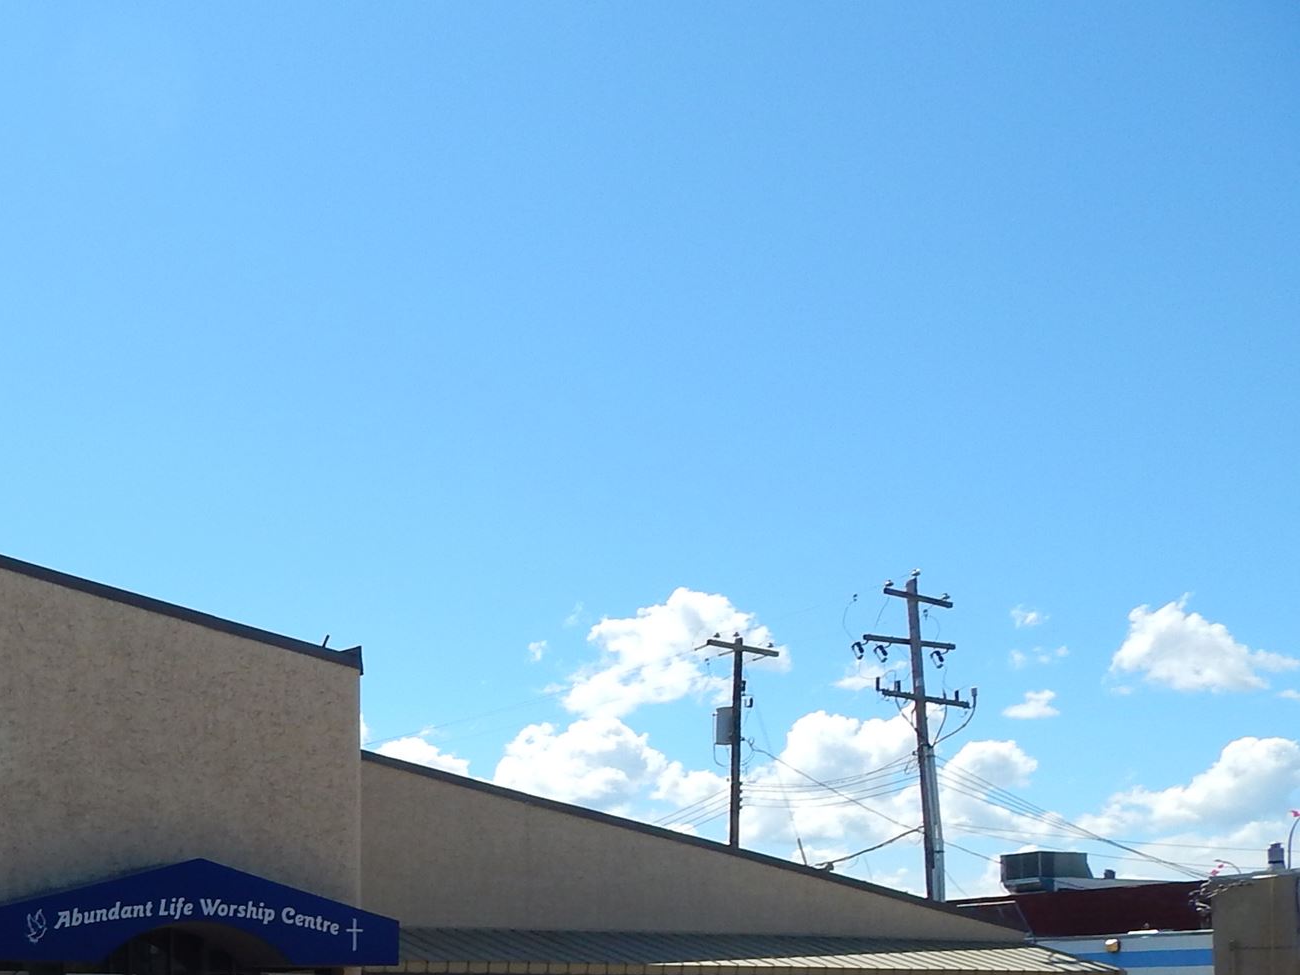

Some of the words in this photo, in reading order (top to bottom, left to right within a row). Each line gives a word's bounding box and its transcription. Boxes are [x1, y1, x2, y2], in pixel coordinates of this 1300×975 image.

[54, 901, 153, 930] Abundant
[158, 897, 194, 920] Life
[200, 898, 275, 925] Worship
[281, 907, 340, 936] Centre
